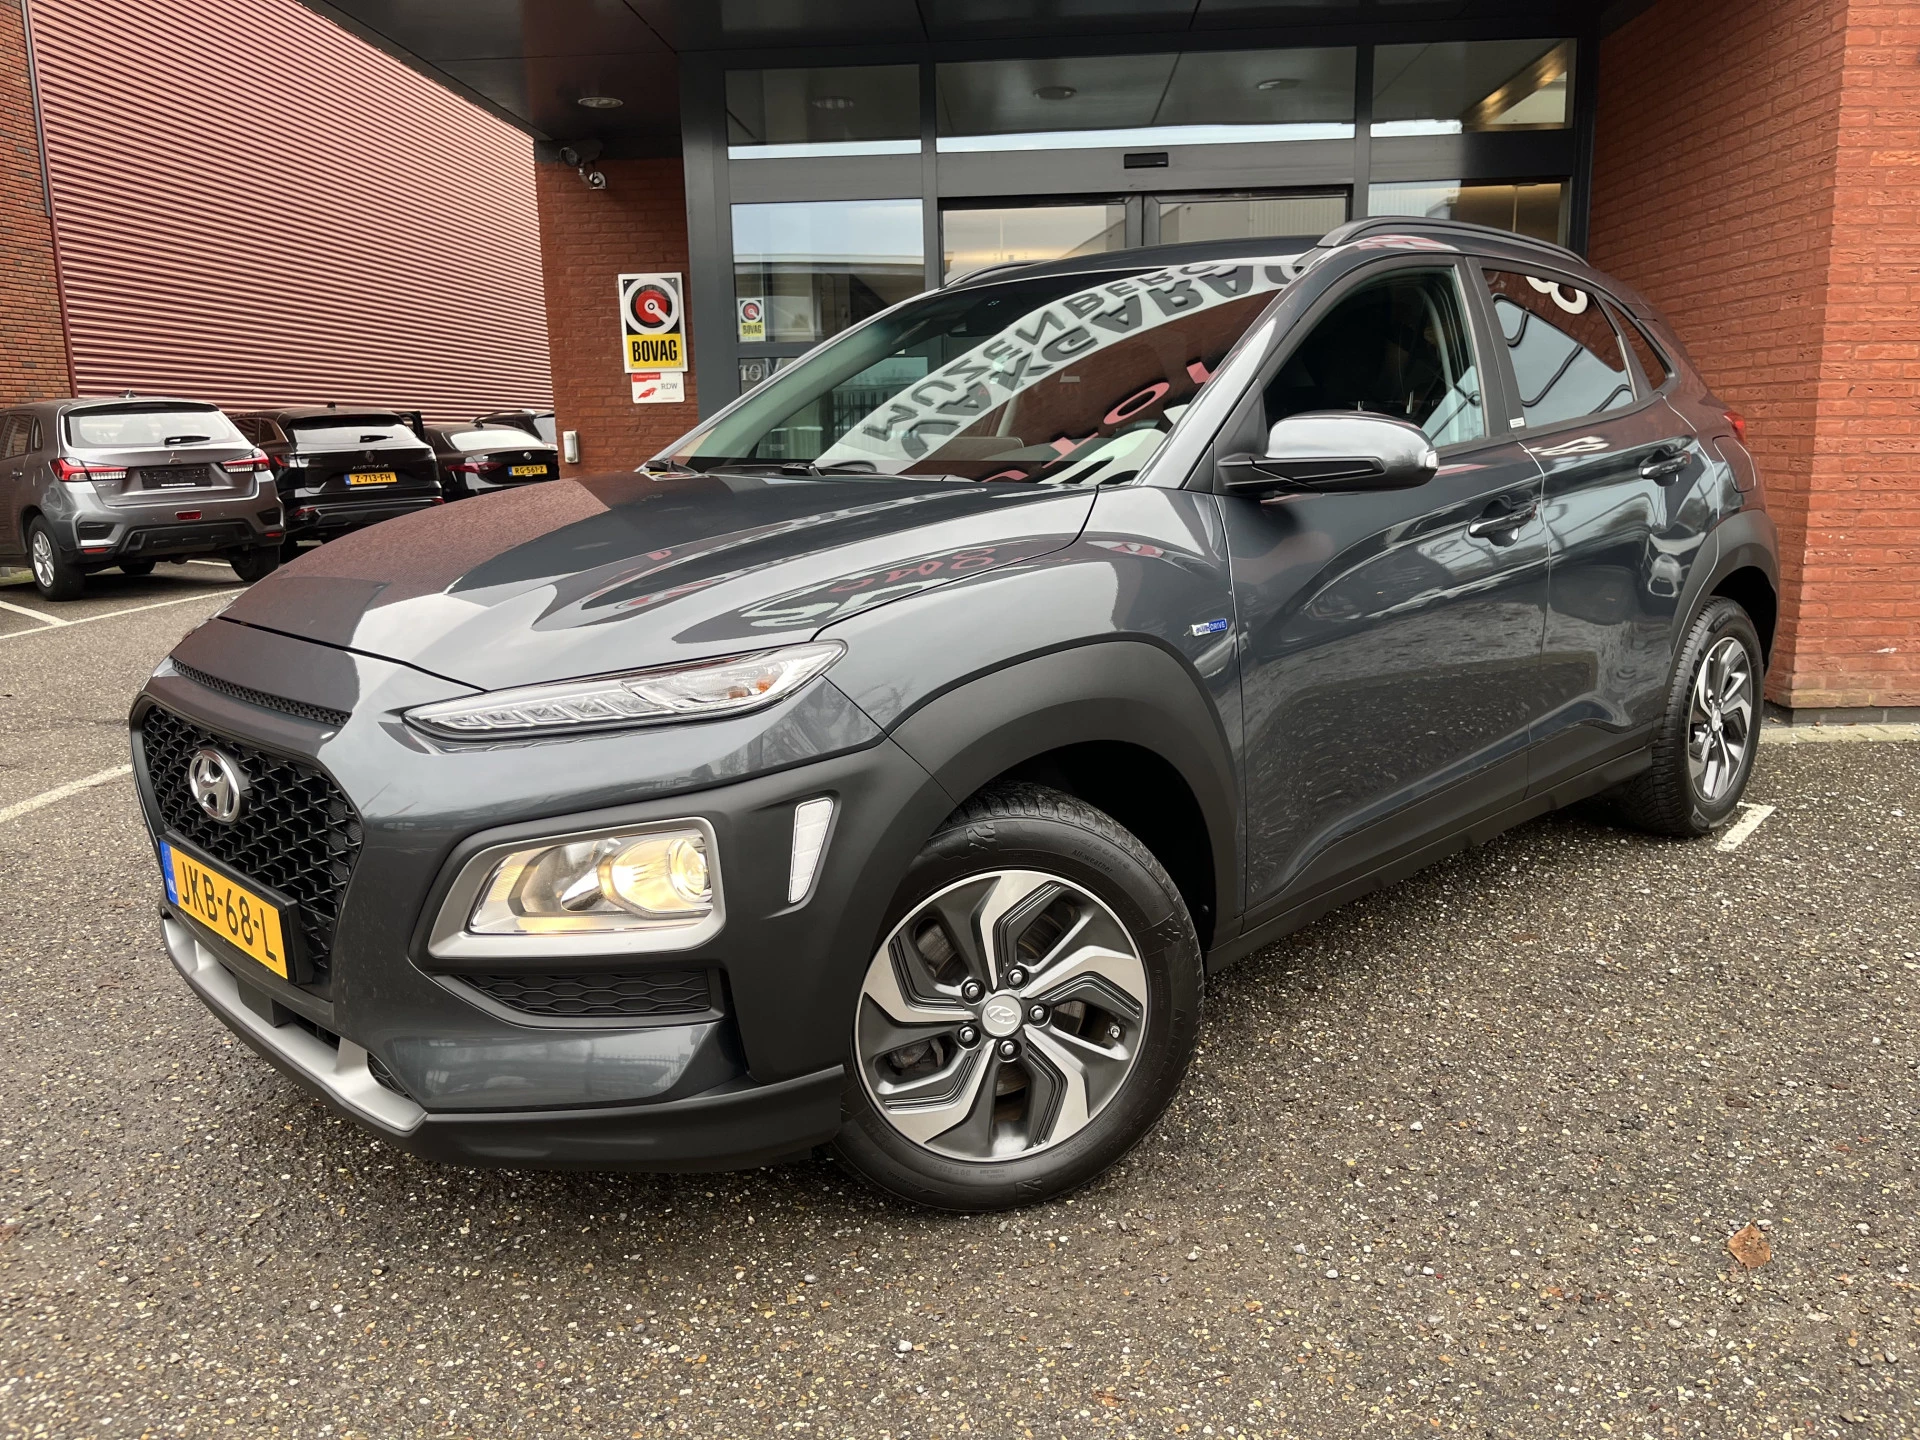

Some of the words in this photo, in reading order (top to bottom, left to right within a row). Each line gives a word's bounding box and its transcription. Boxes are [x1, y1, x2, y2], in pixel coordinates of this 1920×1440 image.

[743, 325, 762, 335] BOVAG
[632, 340, 678, 362] BOVAG
[355, 474, 391, 483] Z-713-FH
[168, 878, 177, 895] NL
[181, 861, 278, 963] JKB-68-L
